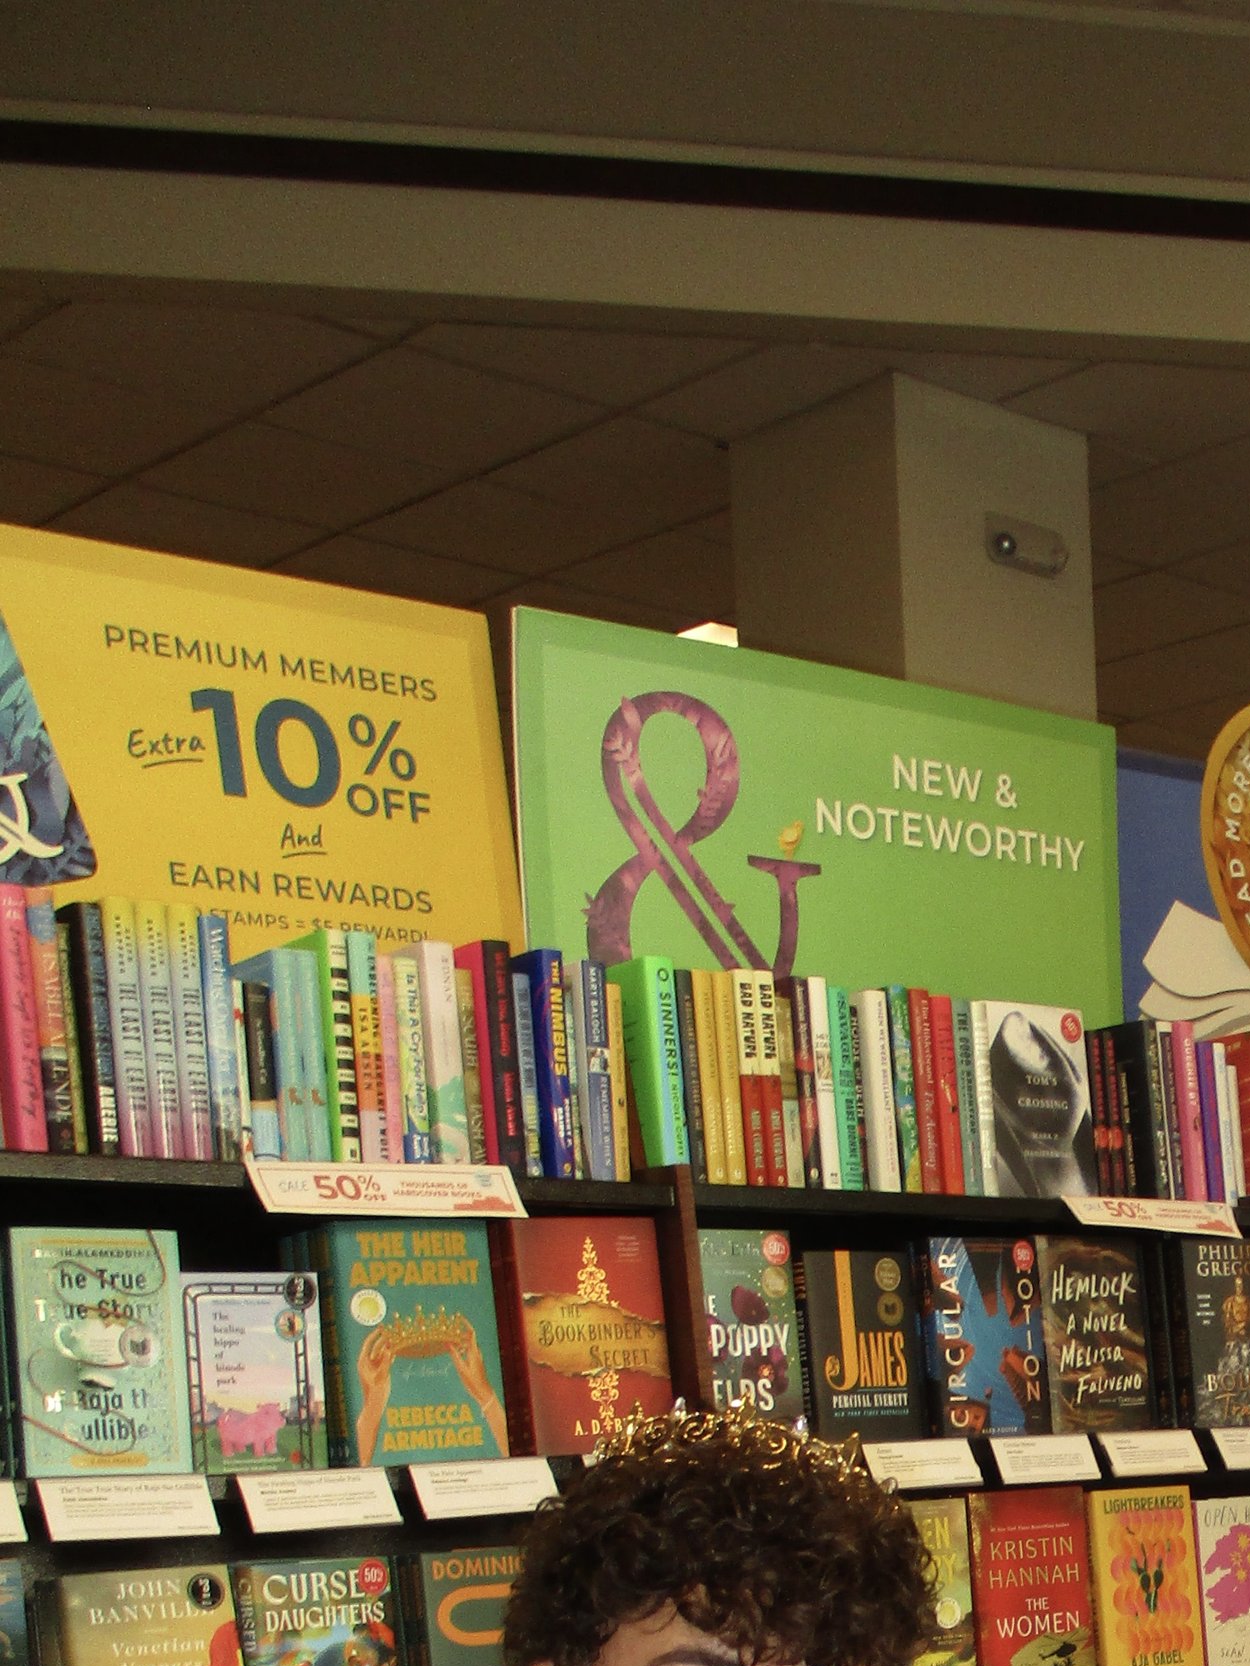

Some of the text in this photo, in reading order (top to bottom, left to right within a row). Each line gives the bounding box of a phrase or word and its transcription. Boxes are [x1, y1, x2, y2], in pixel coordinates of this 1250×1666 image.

[104, 623, 437, 701] PREMIUM MEMBERS
[127, 729, 206, 758] Extra
[892, 753, 1019, 810] NEW &
[347, 783, 431, 824] OFF
[280, 823, 324, 850] And
[815, 798, 1085, 873] NOTEWORTHY
[168, 860, 434, 914] EARN REWARDS
[550, 960, 568, 1078] THE NIMBUS
[740, 982, 756, 1059] BAD NATURE
[759, 982, 777, 1061] BAD NATURE
[659, 991, 679, 1083] SINNERS!
[98, 1084, 119, 1143] AMERIE
[1018, 1097, 1069, 1111] CROSSING
[356, 1231, 468, 1257] THE HEIR
[349, 1258, 479, 1288] APPARENT
[1052, 1265, 1136, 1304] HEMLOCK
[560, 1305, 583, 1319] THE
[825, 1250, 908, 1391] JAMES
[1067, 1316, 1076, 1335] A
[710, 1324, 790, 1357] POPPY
[939, 1252, 970, 1428] CIRCULAR
[589, 1346, 651, 1368] SECRET
[833, 1394, 908, 1408] PERCIVAL EVERETT
[387, 1403, 474, 1428] REBECCA
[382, 1427, 484, 1452] ARMITAGE
[1103, 1494, 1185, 1515] LIGHTBREAKERS
[990, 1536, 1074, 1561] KRISTIN
[988, 1562, 1081, 1589] HANNAH
[116, 1581, 181, 1600] JOHN
[265, 1603, 386, 1633] DAUGHTERS
[1025, 1598, 1050, 1612] THE
[996, 1611, 1081, 1639] WOMEN
[112, 1638, 206, 1658] Venetian
[1131, 1649, 1184, 1666] AJA GABEL
